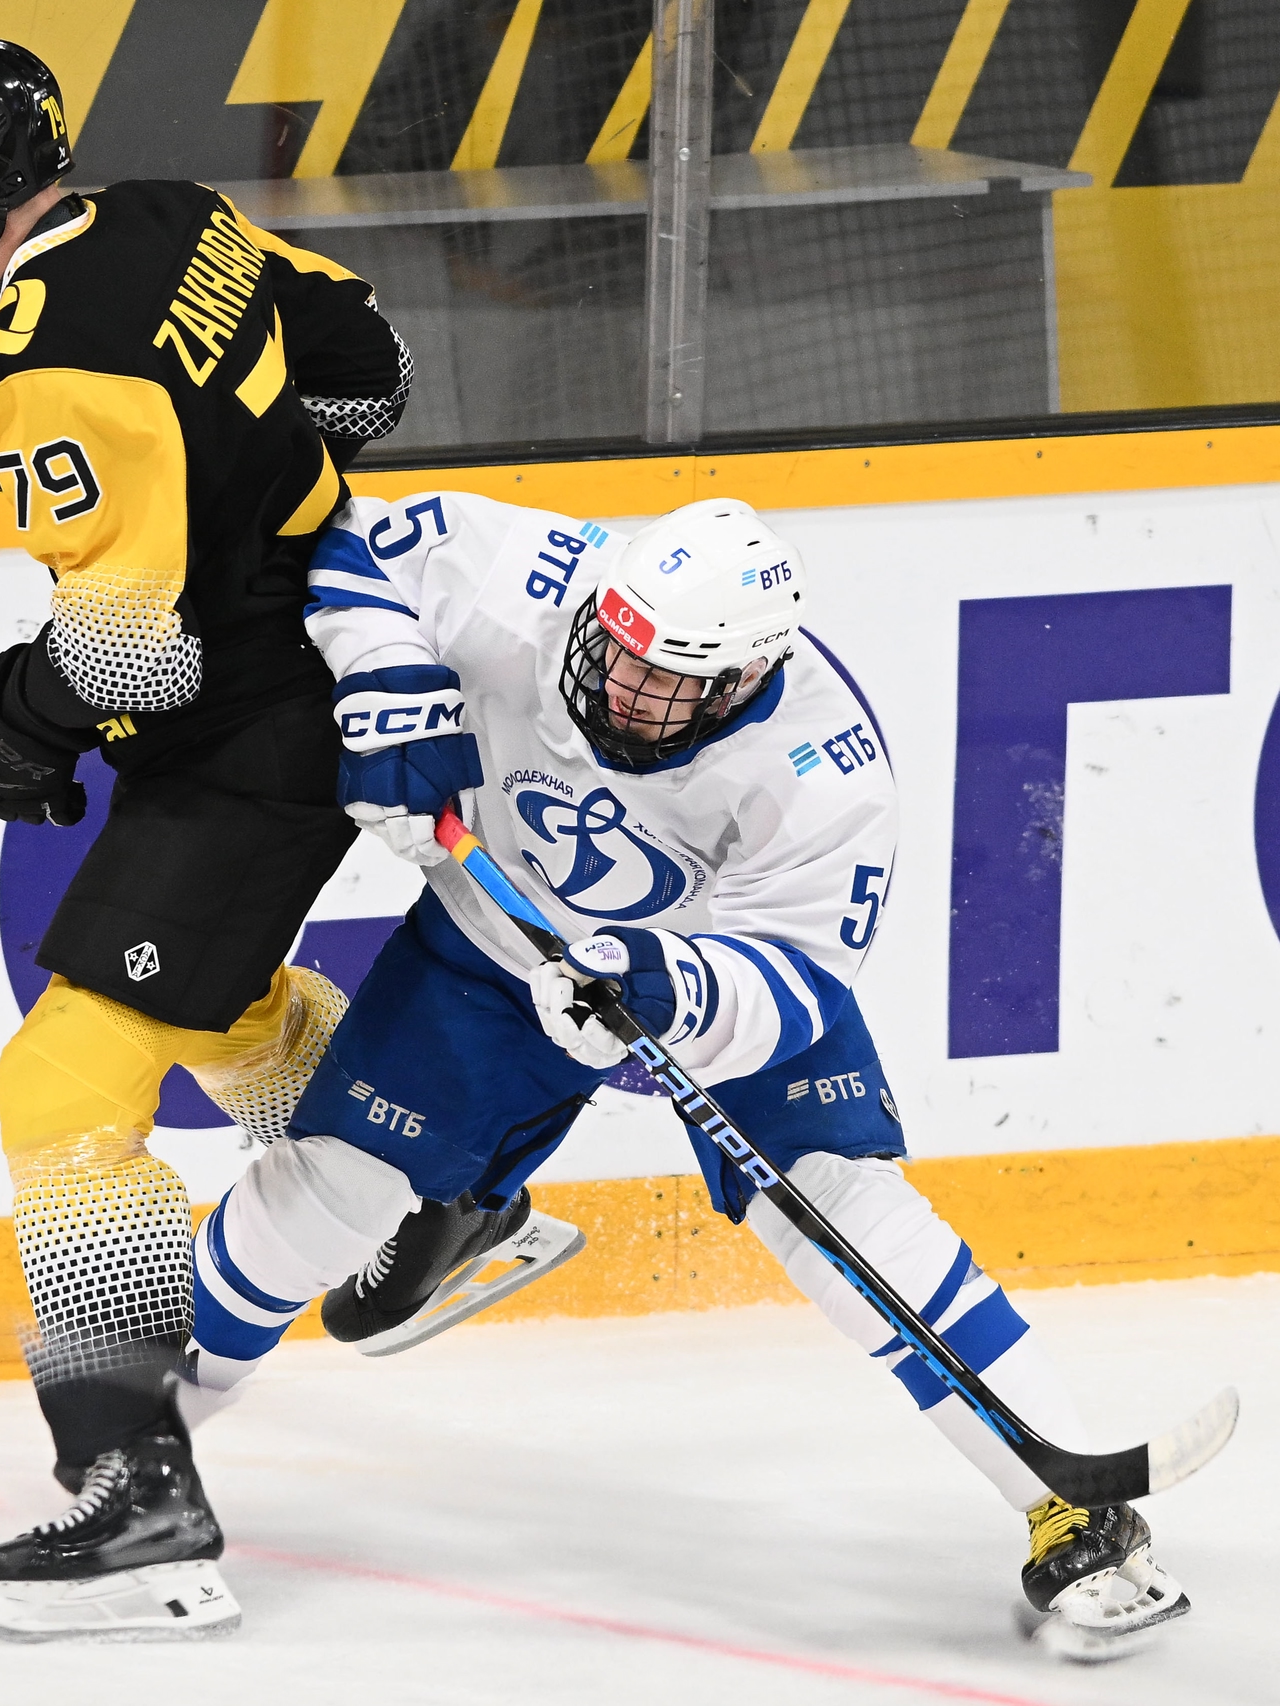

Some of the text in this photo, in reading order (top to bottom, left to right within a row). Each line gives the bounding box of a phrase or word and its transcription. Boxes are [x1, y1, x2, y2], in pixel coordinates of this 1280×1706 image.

[41, 95, 66, 140] 79
[152, 211, 266, 388] ZAKHARO
[368, 496, 448, 560] 5
[525, 529, 587, 608] ВТБ
[658, 547, 691, 575] 5
[759, 560, 792, 590] ВТБ
[599, 609, 644, 652] OLIMPBET
[751, 628, 790, 648] CCM
[340, 702, 466, 738] CCM
[821, 723, 876, 776] ВТБ
[501, 769, 574, 798] МОЛОДЕЖНАЯ
[839, 864, 885, 950] 5
[814, 1071, 866, 1105] ВТБ
[366, 1095, 427, 1139] ВТБ
